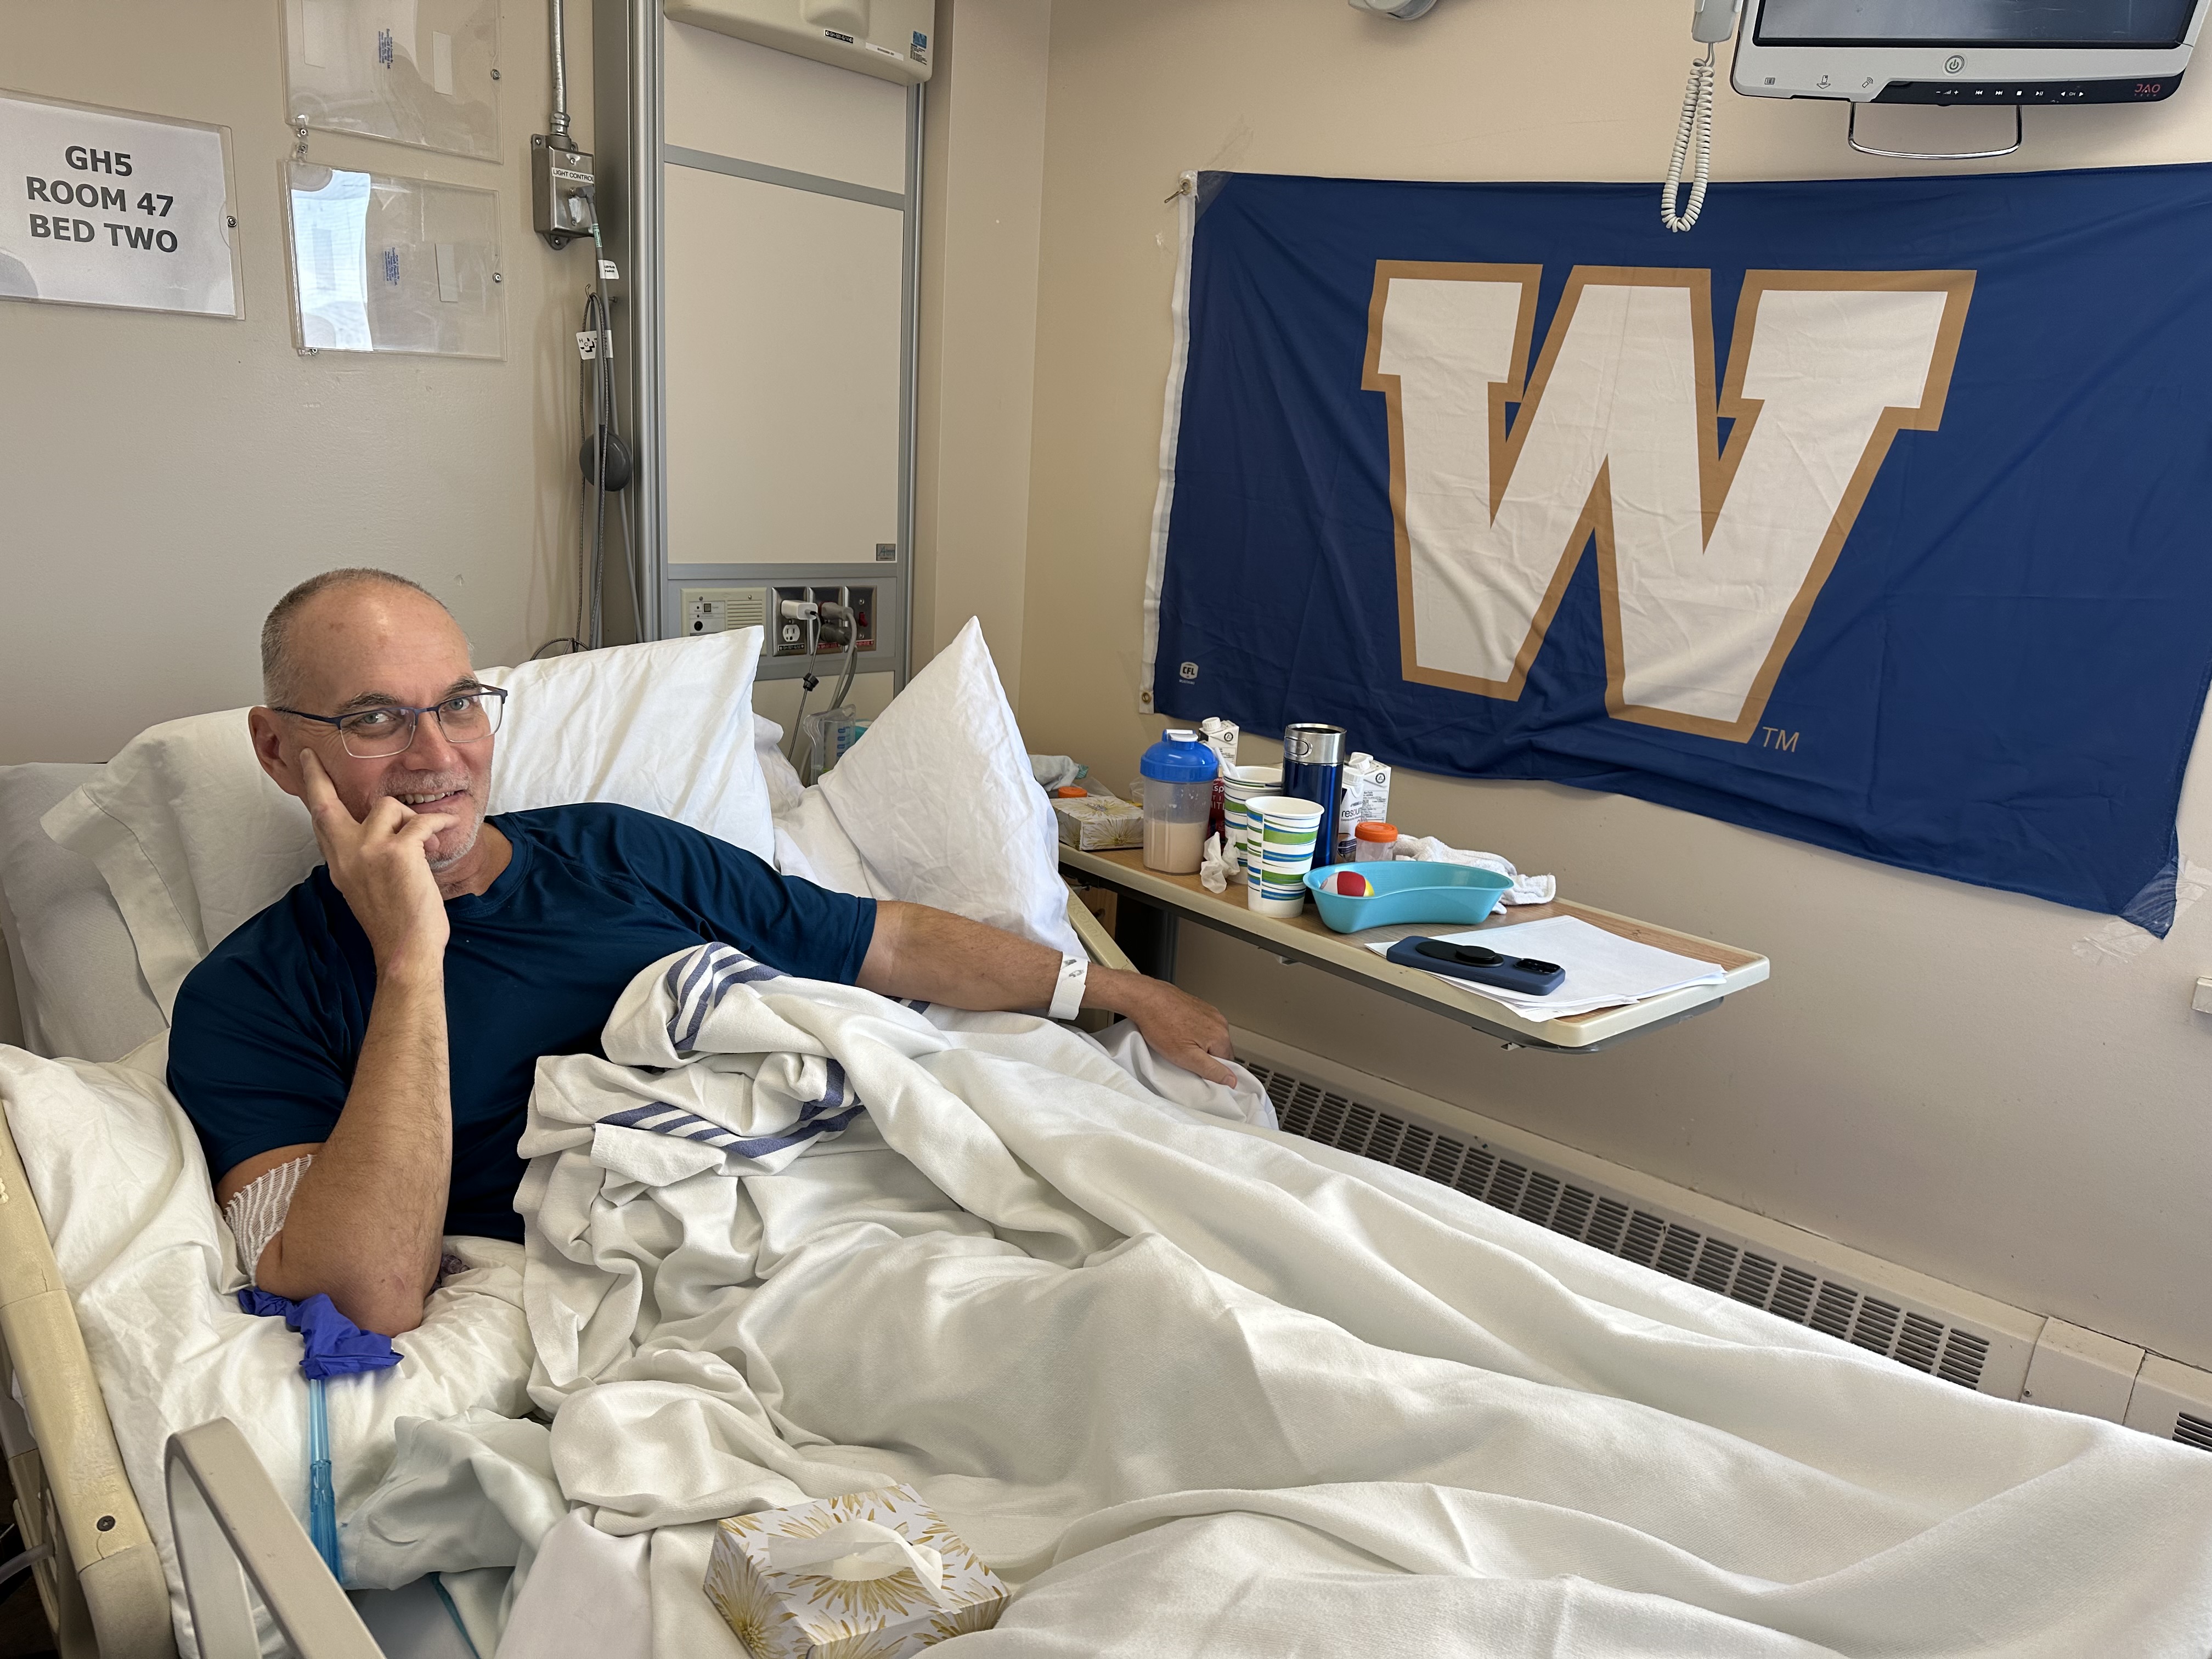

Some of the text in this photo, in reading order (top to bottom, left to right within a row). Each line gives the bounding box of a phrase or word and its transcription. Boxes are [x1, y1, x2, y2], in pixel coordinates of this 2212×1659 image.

[2135, 83, 2161, 93] JAO
[65, 145, 132, 177] GH5
[569, 172, 594, 182] CONTROL
[26, 176, 173, 217] ROOM 47
[30, 213, 178, 252] BED TWO
[1361, 259, 1977, 743] W
[1183, 667, 1195, 675] CFL
[1762, 726, 1799, 753] TM
[1342, 808, 1362, 817] resou
